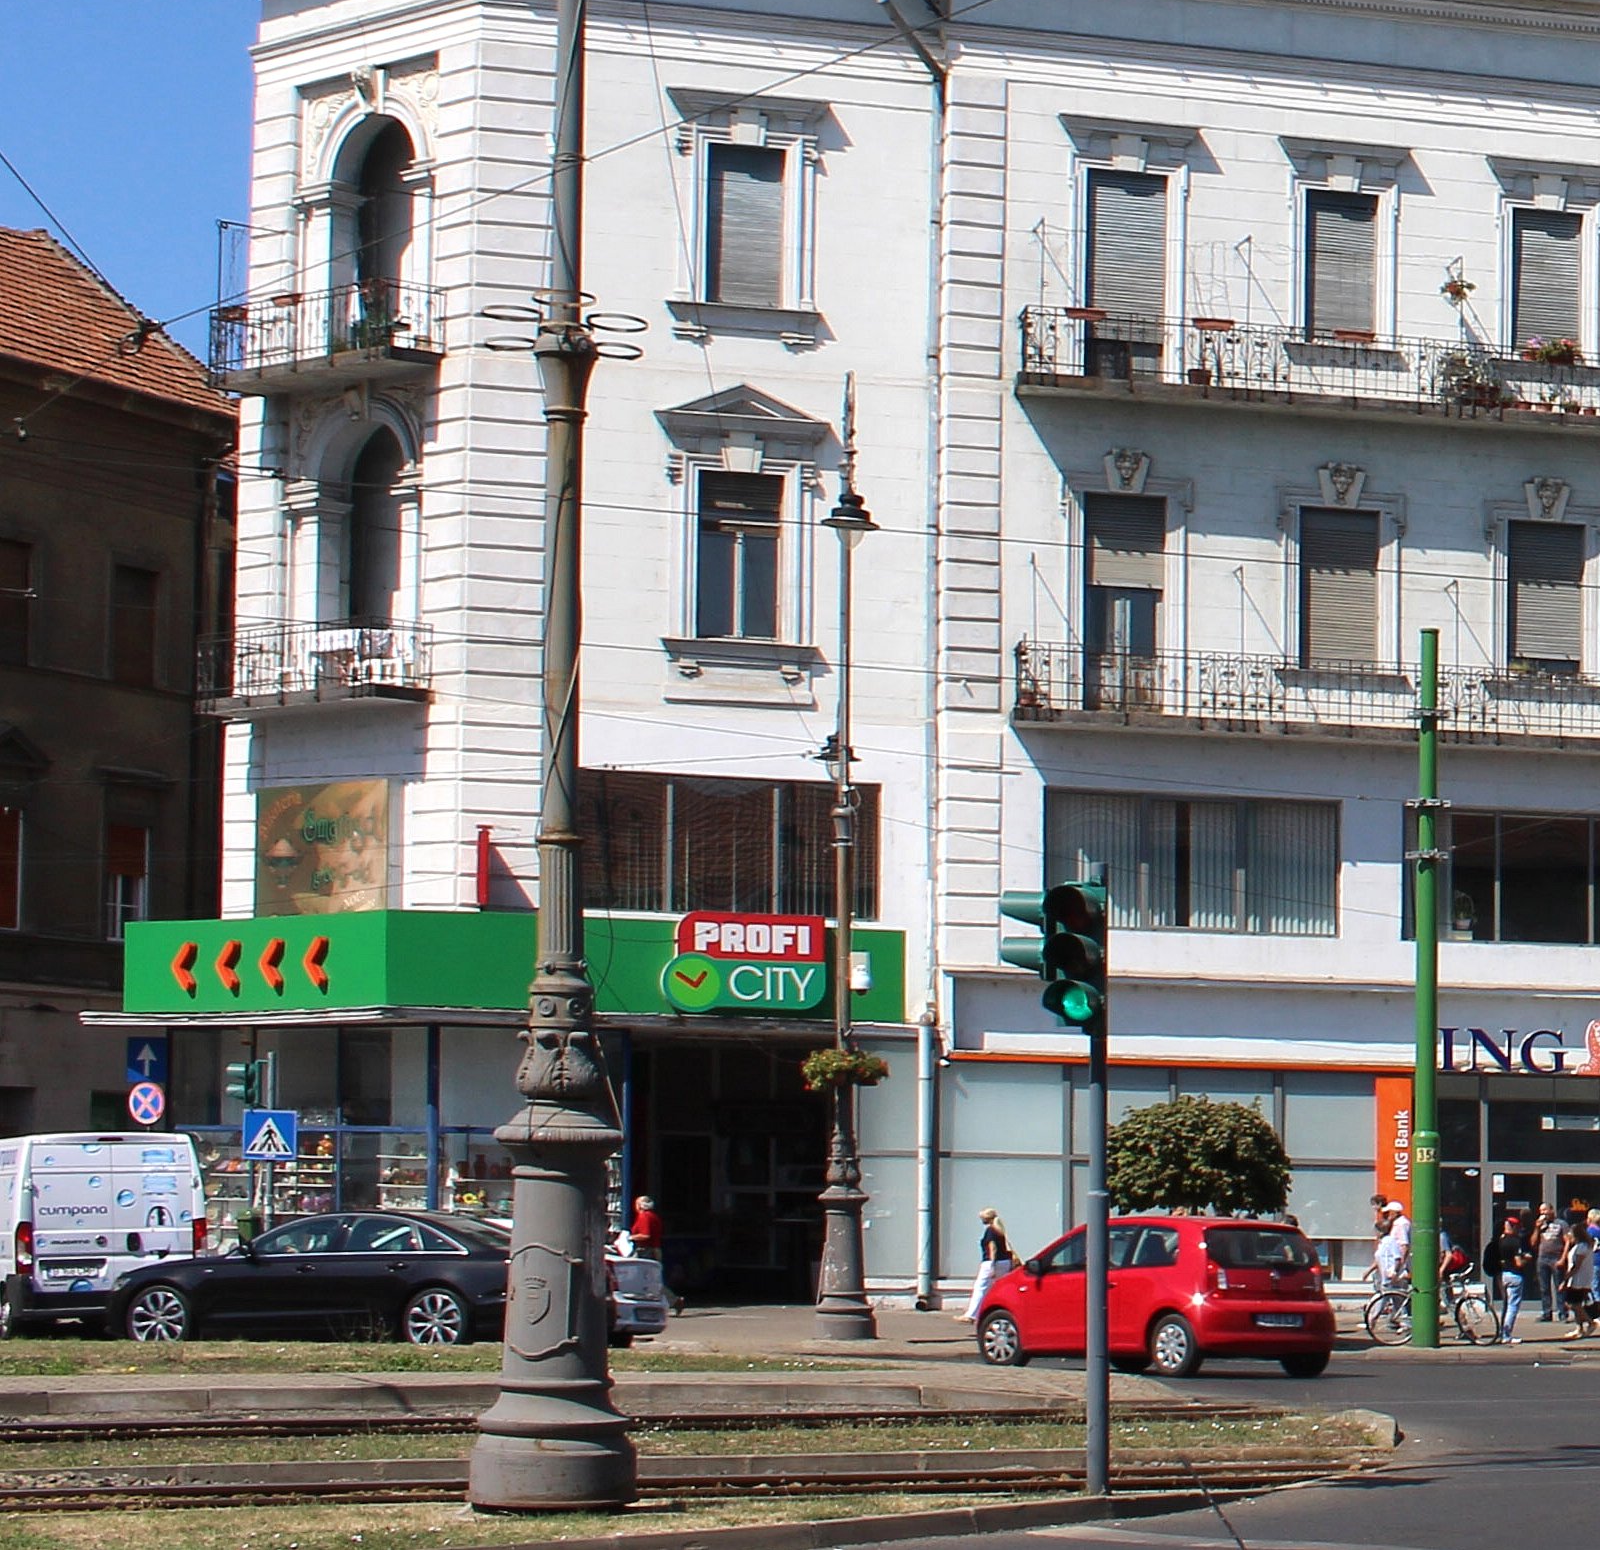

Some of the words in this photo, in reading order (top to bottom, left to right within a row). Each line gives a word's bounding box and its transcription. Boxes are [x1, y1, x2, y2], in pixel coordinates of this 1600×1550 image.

[694, 921, 811, 955] PROFI
[729, 965, 815, 1002] CITY
[1437, 1026, 1568, 1075] ING
[1393, 1110, 1409, 1148] Bank
[1394, 1152, 1409, 1181] ING
